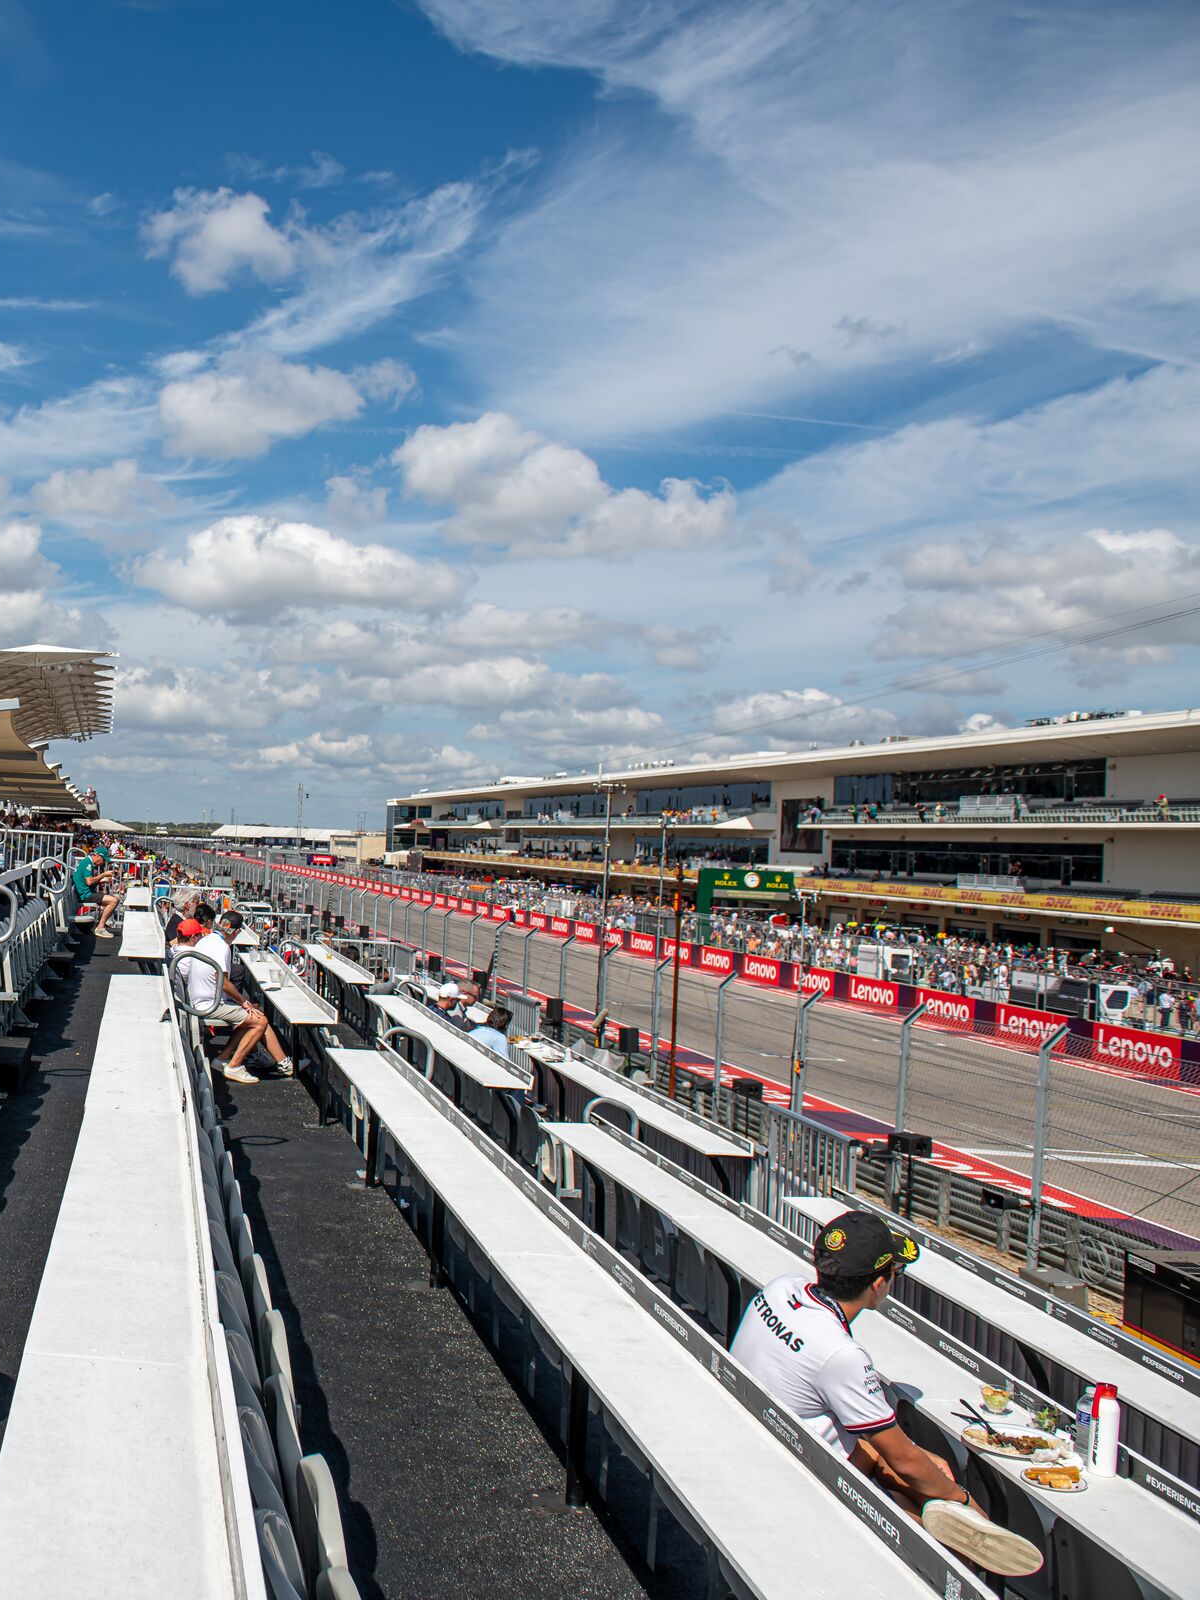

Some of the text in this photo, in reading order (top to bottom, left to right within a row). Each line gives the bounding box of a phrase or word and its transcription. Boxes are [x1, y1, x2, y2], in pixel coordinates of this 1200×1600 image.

[857, 883, 874, 892] DHL
[887, 885, 907, 895] DHL
[922, 888, 943, 898] DHL
[960, 891, 983, 901] DHL
[1000, 894, 1026, 905] DHL
[1044, 897, 1073, 909] DHL
[1094, 901, 1125, 914] DHL
[1150, 905, 1183, 918] DHL
[530, 914, 545, 928] Lenovo
[551, 918, 568, 932] Lenovo
[575, 924, 593, 938] Lenovo
[631, 935, 653, 952] Lenovo
[702, 946, 730, 970] Lenovo
[745, 957, 776, 980] Lenovo
[793, 966, 831, 991] Lenovo
[851, 978, 894, 1006] Lenovo
[919, 992, 970, 1022] Lenovo
[1098, 1028, 1173, 1068] Lenovo
[653, 1302, 688, 1342] #EXPERIENCEF1
[938, 1340, 980, 1373] #EXPERIENCEF1
[1142, 1355, 1184, 1383] #EXPERIENCEF1
[762, 1408, 803, 1454] Champions Club
[836, 1476, 901, 1545] #EXPERIENCEF1
